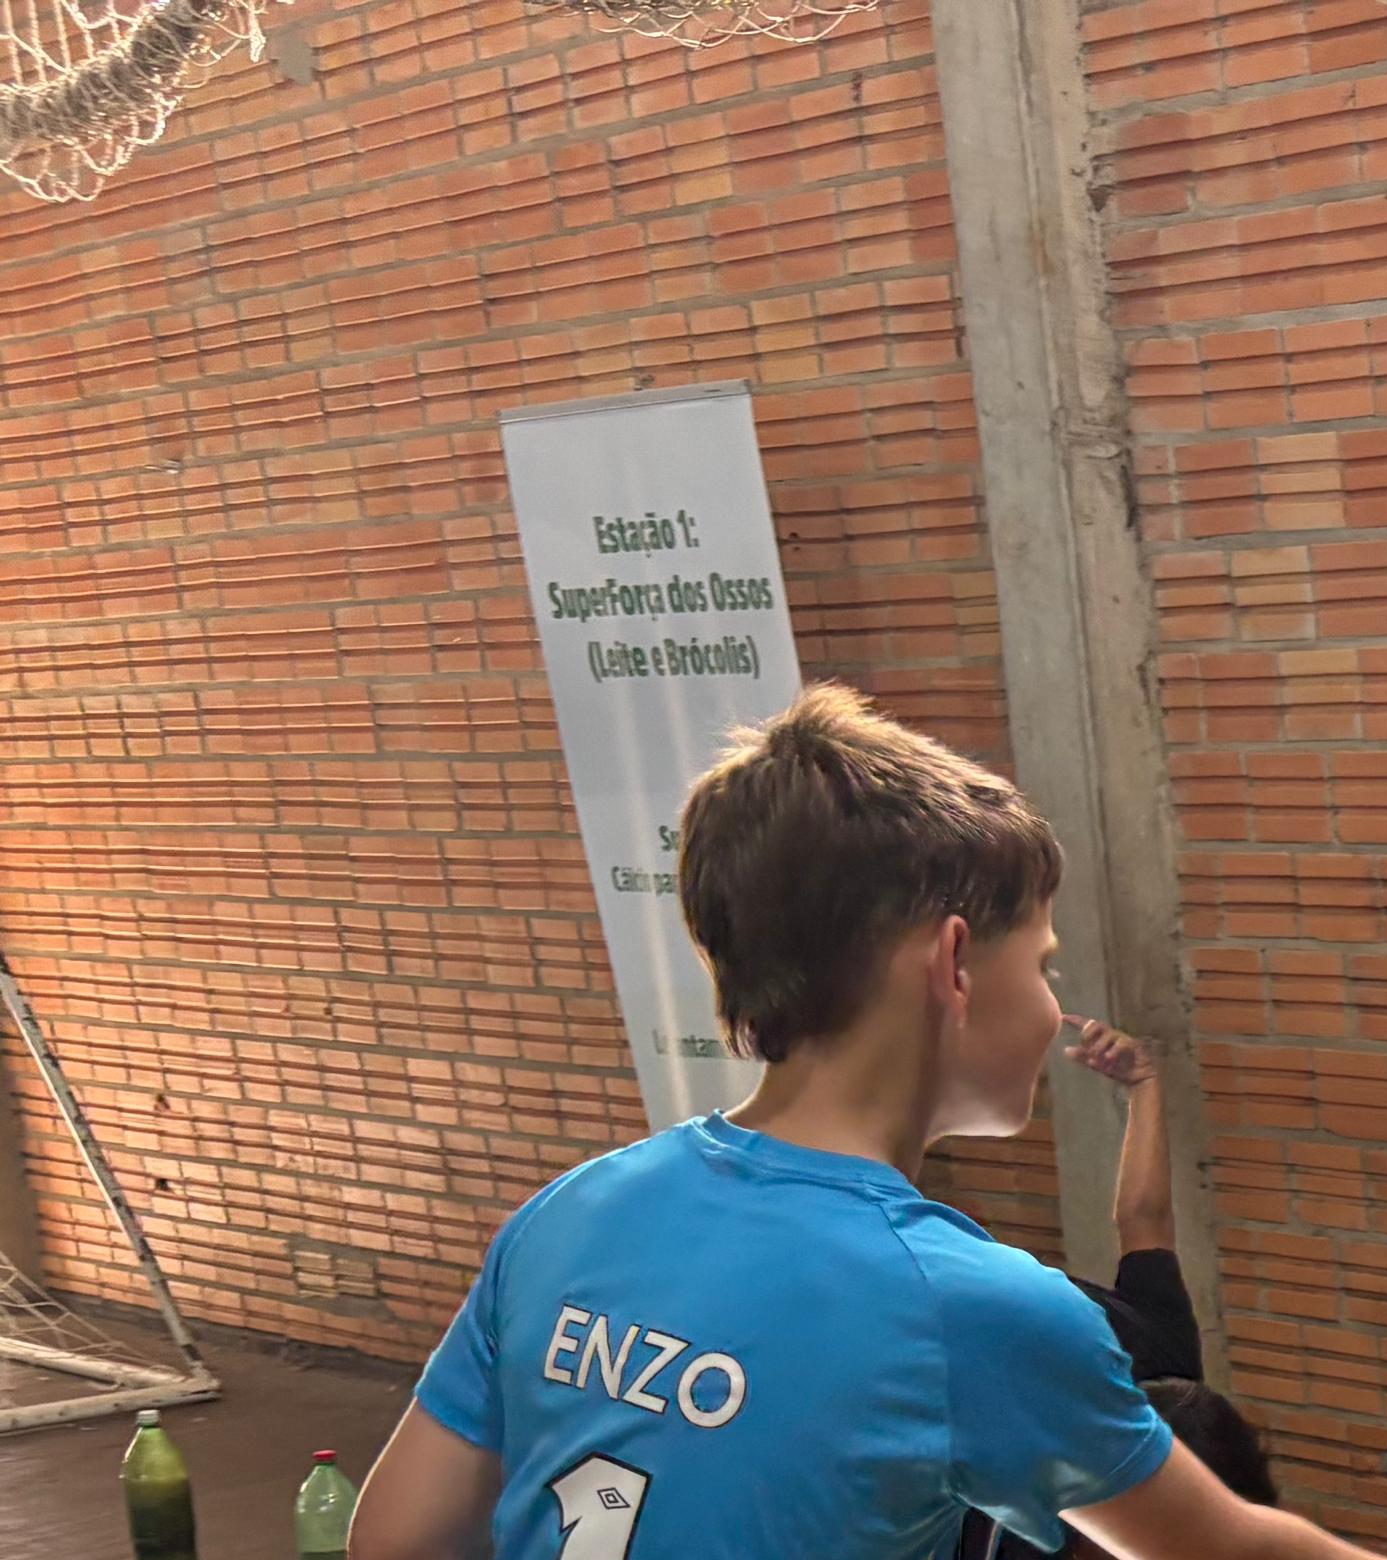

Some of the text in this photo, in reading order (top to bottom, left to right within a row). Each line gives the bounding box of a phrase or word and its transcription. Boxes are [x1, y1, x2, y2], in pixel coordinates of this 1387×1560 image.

[593, 510, 700, 558] Estação 1:
[667, 574, 708, 613] dos
[709, 572, 774, 611] Ossos
[652, 646, 665, 677] e
[543, 1304, 748, 1429] ENZO
